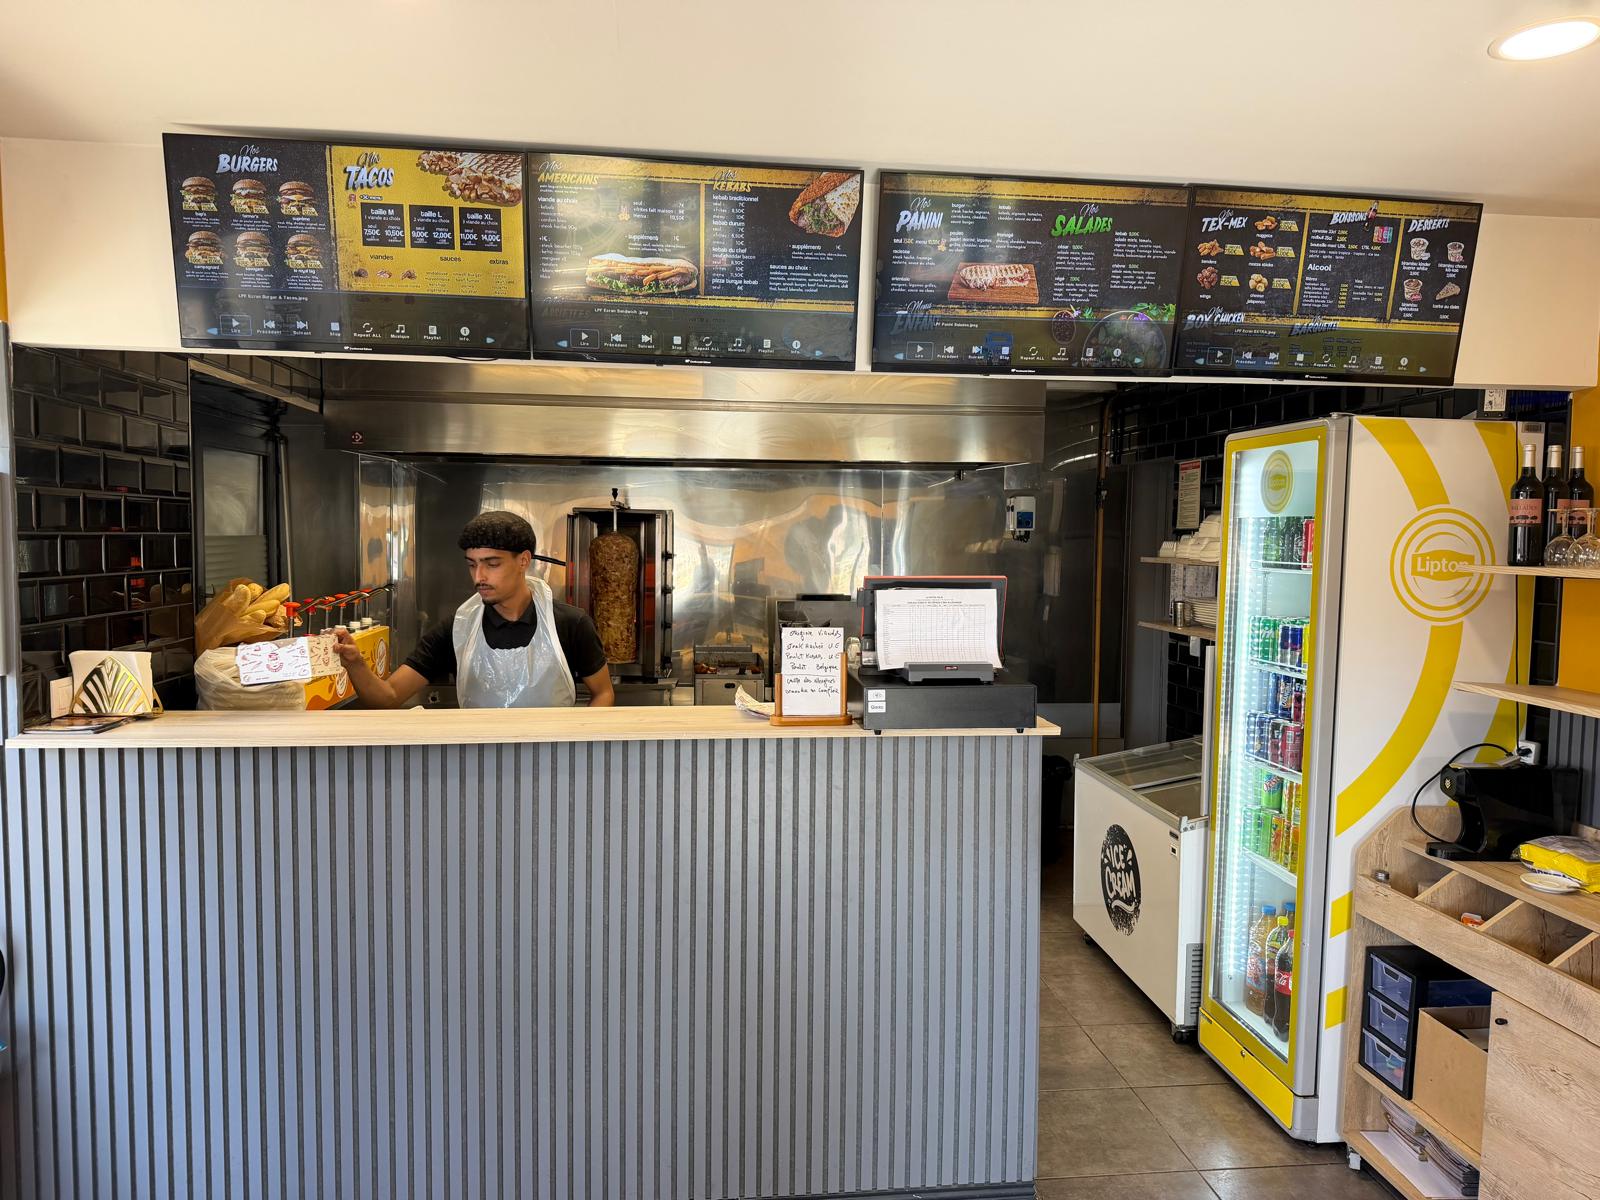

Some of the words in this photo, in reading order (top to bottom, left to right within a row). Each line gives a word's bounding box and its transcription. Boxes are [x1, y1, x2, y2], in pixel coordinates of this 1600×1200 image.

[216, 154, 278, 174] BURGERS
[346, 166, 394, 190] TACOS
[537, 172, 600, 184] AMERICAINS
[712, 182, 752, 192] KEBABS
[910, 197, 932, 211] Nos
[896, 210, 944, 232] PANINI
[1051, 214, 1113, 236] SALADES
[1201, 216, 1248, 232] TEX-MEX
[1330, 212, 1368, 225] BOISSONS
[1408, 218, 1450, 232] DESSERTS
[481, 234, 500, 242] 14,00€
[1307, 264, 1332, 272] Alcool
[1184, 313, 1212, 330] BOX
[1214, 312, 1246, 324] CHICKEN
[1110, 844, 1126, 870] ICE
[1105, 866, 1136, 900] CREAM
